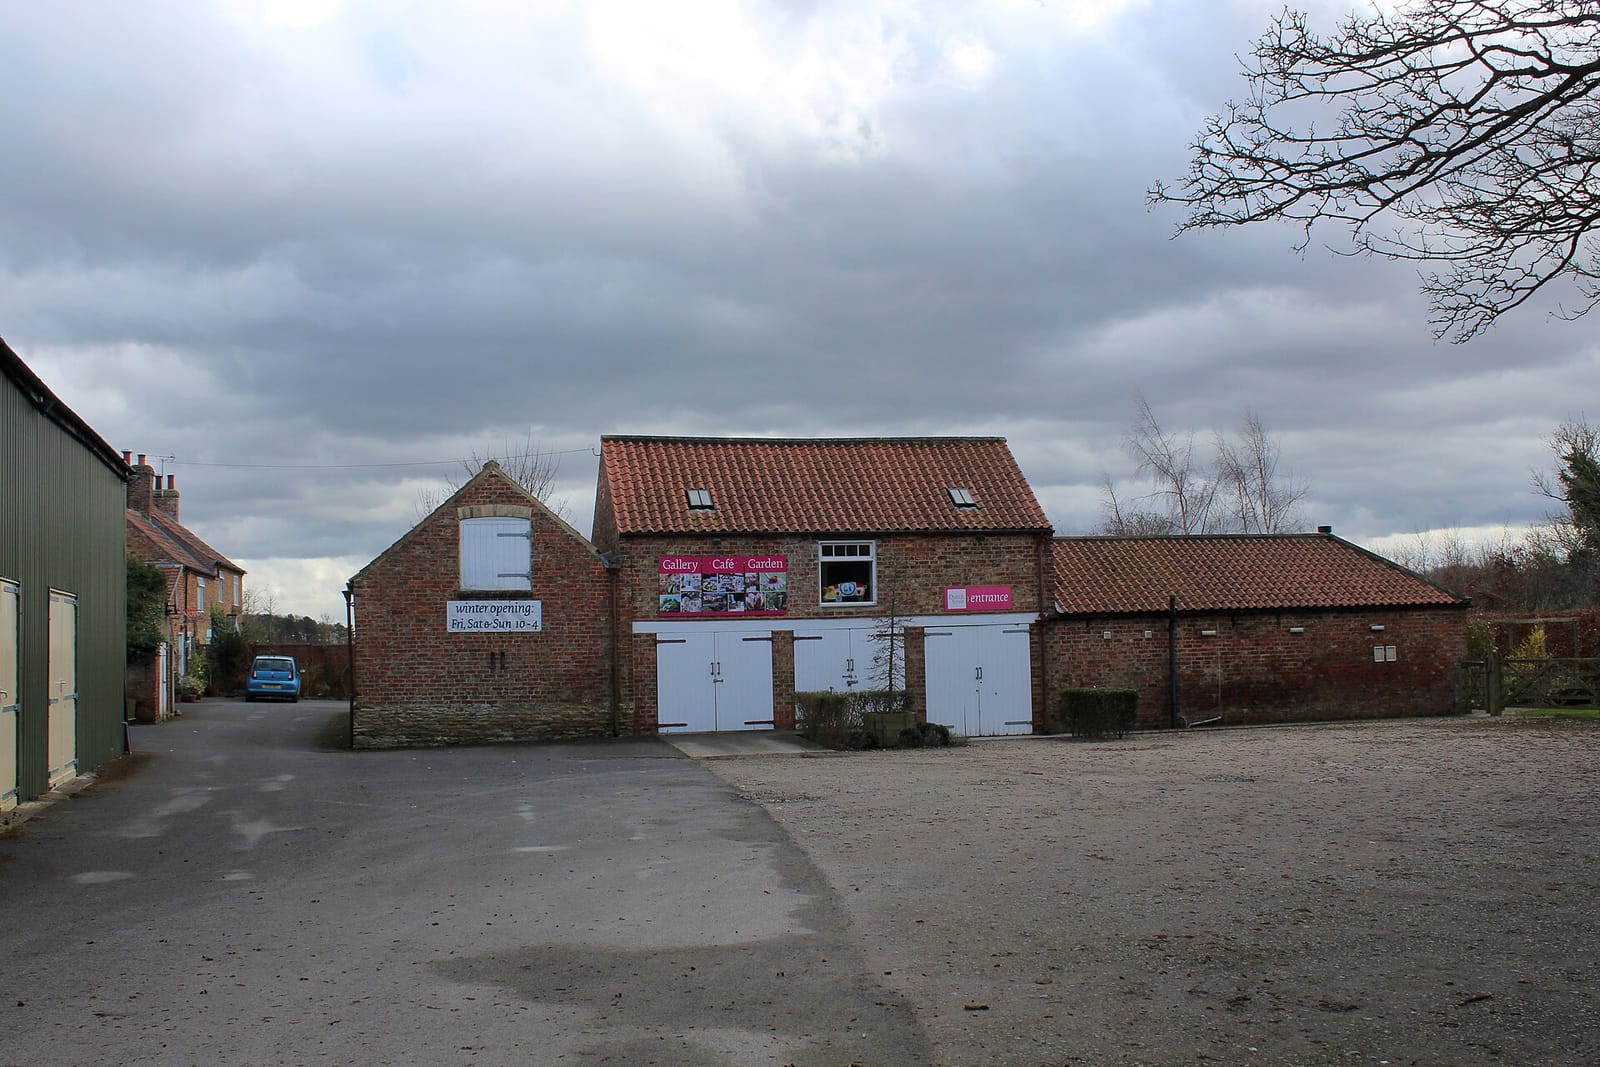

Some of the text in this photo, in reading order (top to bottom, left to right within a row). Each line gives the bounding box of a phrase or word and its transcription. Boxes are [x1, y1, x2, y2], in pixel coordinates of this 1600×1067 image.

[662, 558, 783, 573] Gallery Café Garden
[970, 594, 1009, 603] entrance
[456, 602, 535, 616] winter opening:
[451, 618, 466, 630] Fri,
[467, 619, 483, 629] Sat
[493, 619, 512, 629] Sun
